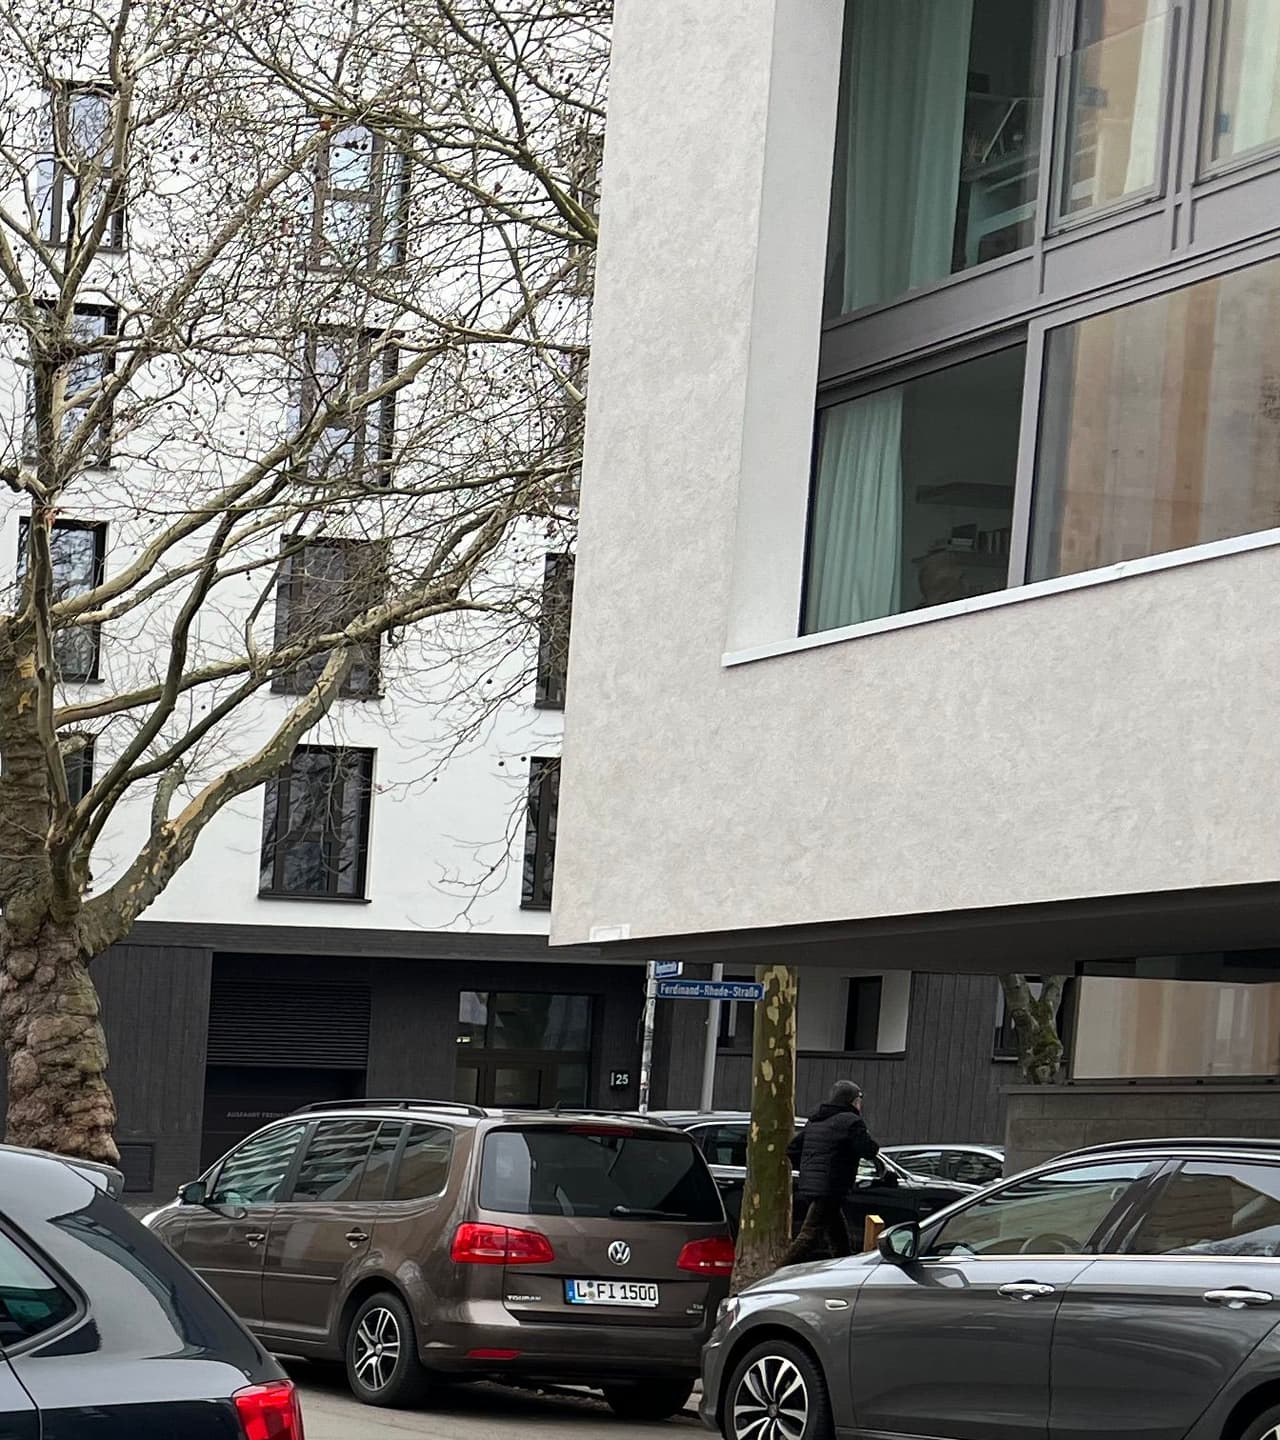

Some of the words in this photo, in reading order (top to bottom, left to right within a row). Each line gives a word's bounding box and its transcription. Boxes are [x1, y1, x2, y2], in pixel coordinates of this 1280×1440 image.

[660, 983, 759, 998] Ferdinand-Rhode-Straße
[615, 1073, 629, 1085] 25
[597, 1283, 616, 1299] FI
[620, 1284, 657, 1301] 1500
